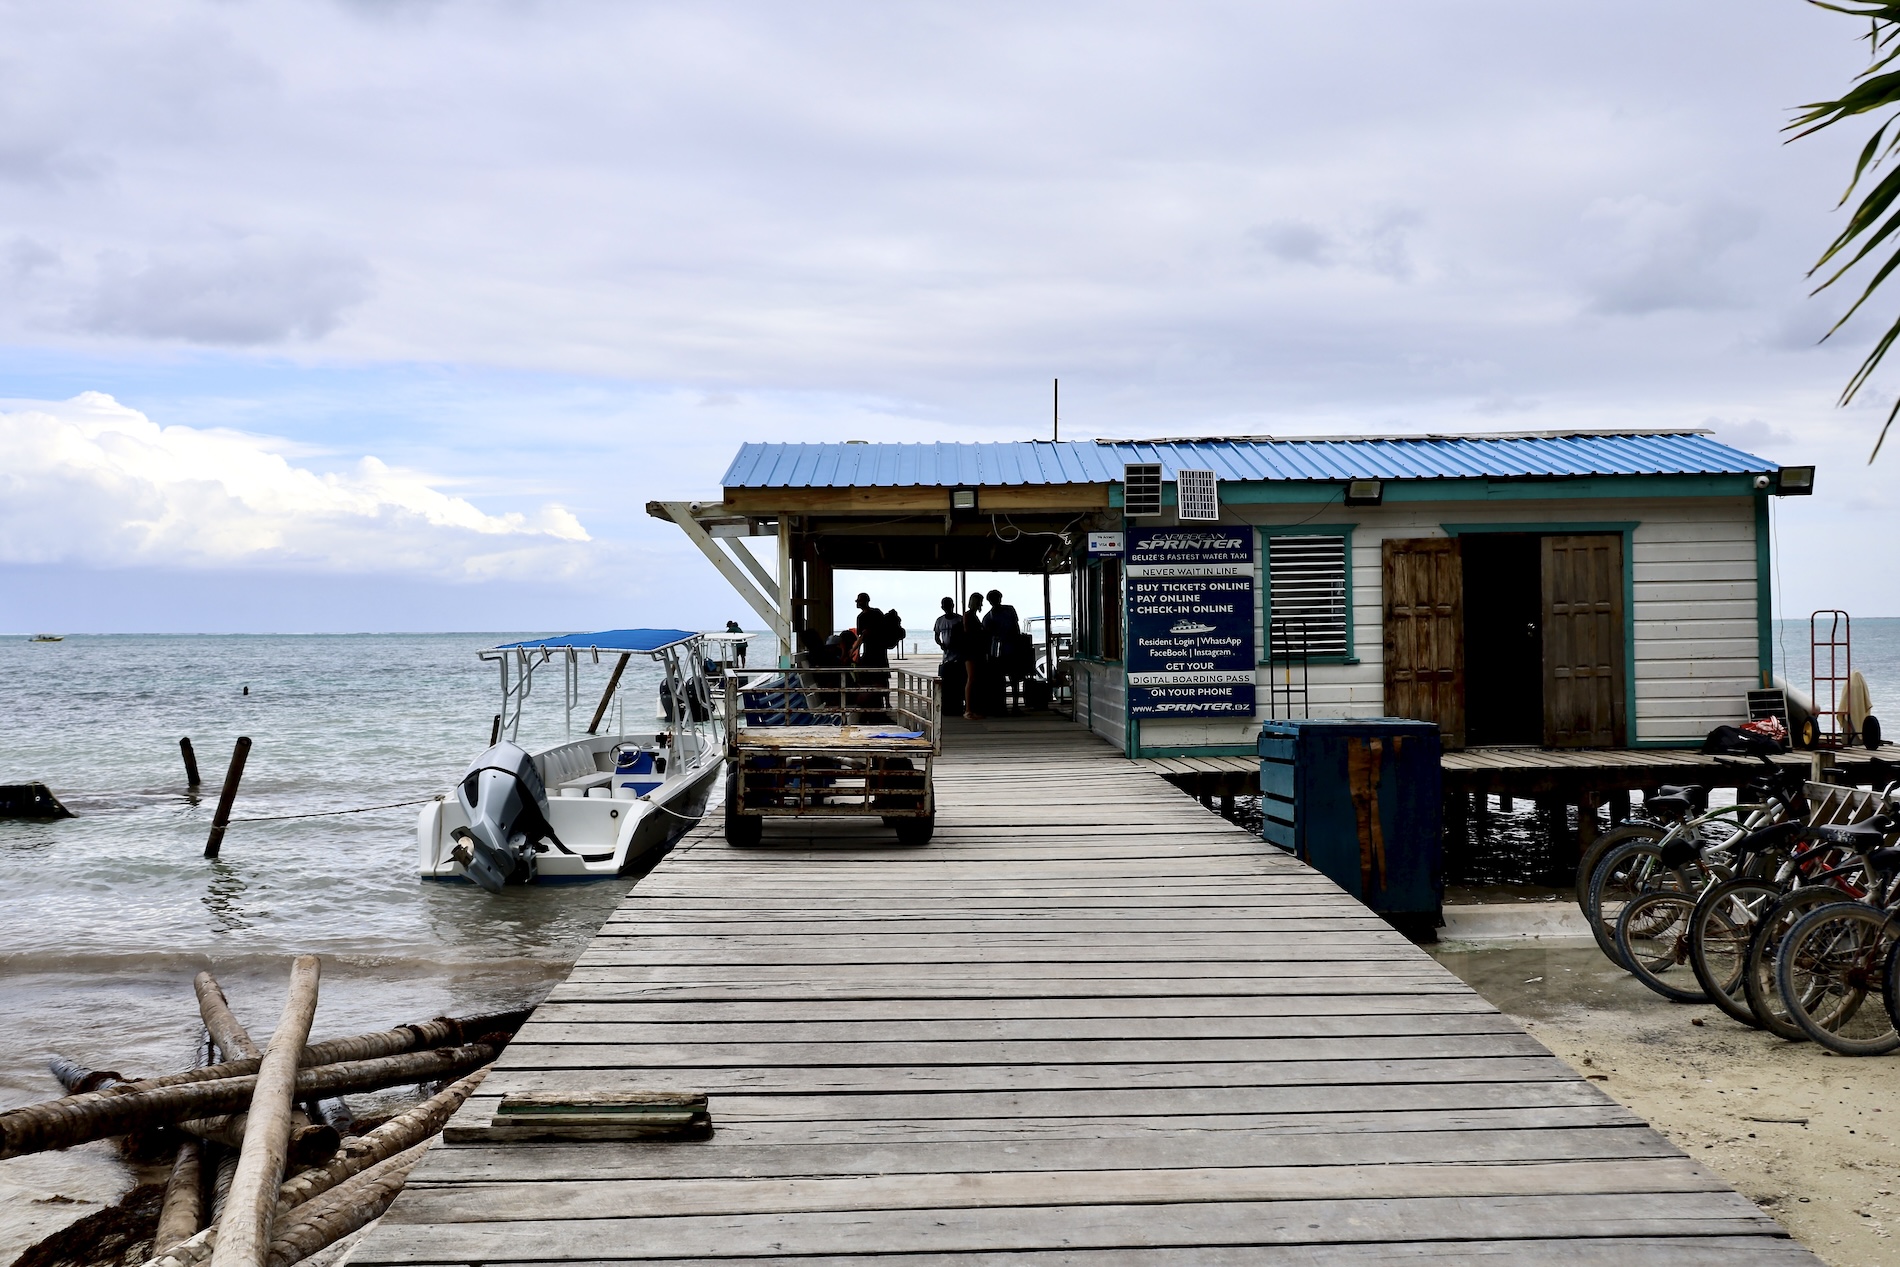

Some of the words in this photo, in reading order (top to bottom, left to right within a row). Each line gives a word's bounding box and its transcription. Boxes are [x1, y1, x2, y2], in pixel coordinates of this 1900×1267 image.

[1136, 539, 1243, 550] SPRINTER
[1161, 583, 1206, 591] TICKETS
[1209, 582, 1250, 591] ONLINE
[1159, 594, 1200, 602] ONLINE
[1137, 606, 1190, 614] CHECK-IN
[1192, 605, 1233, 613] ONLINE
[1139, 638, 1172, 646] Resident
[1174, 638, 1195, 646] Login
[1201, 637, 1242, 646] WhatsApp
[1150, 649, 1187, 657] FaceBook
[1194, 649, 1231, 658] Instagram
